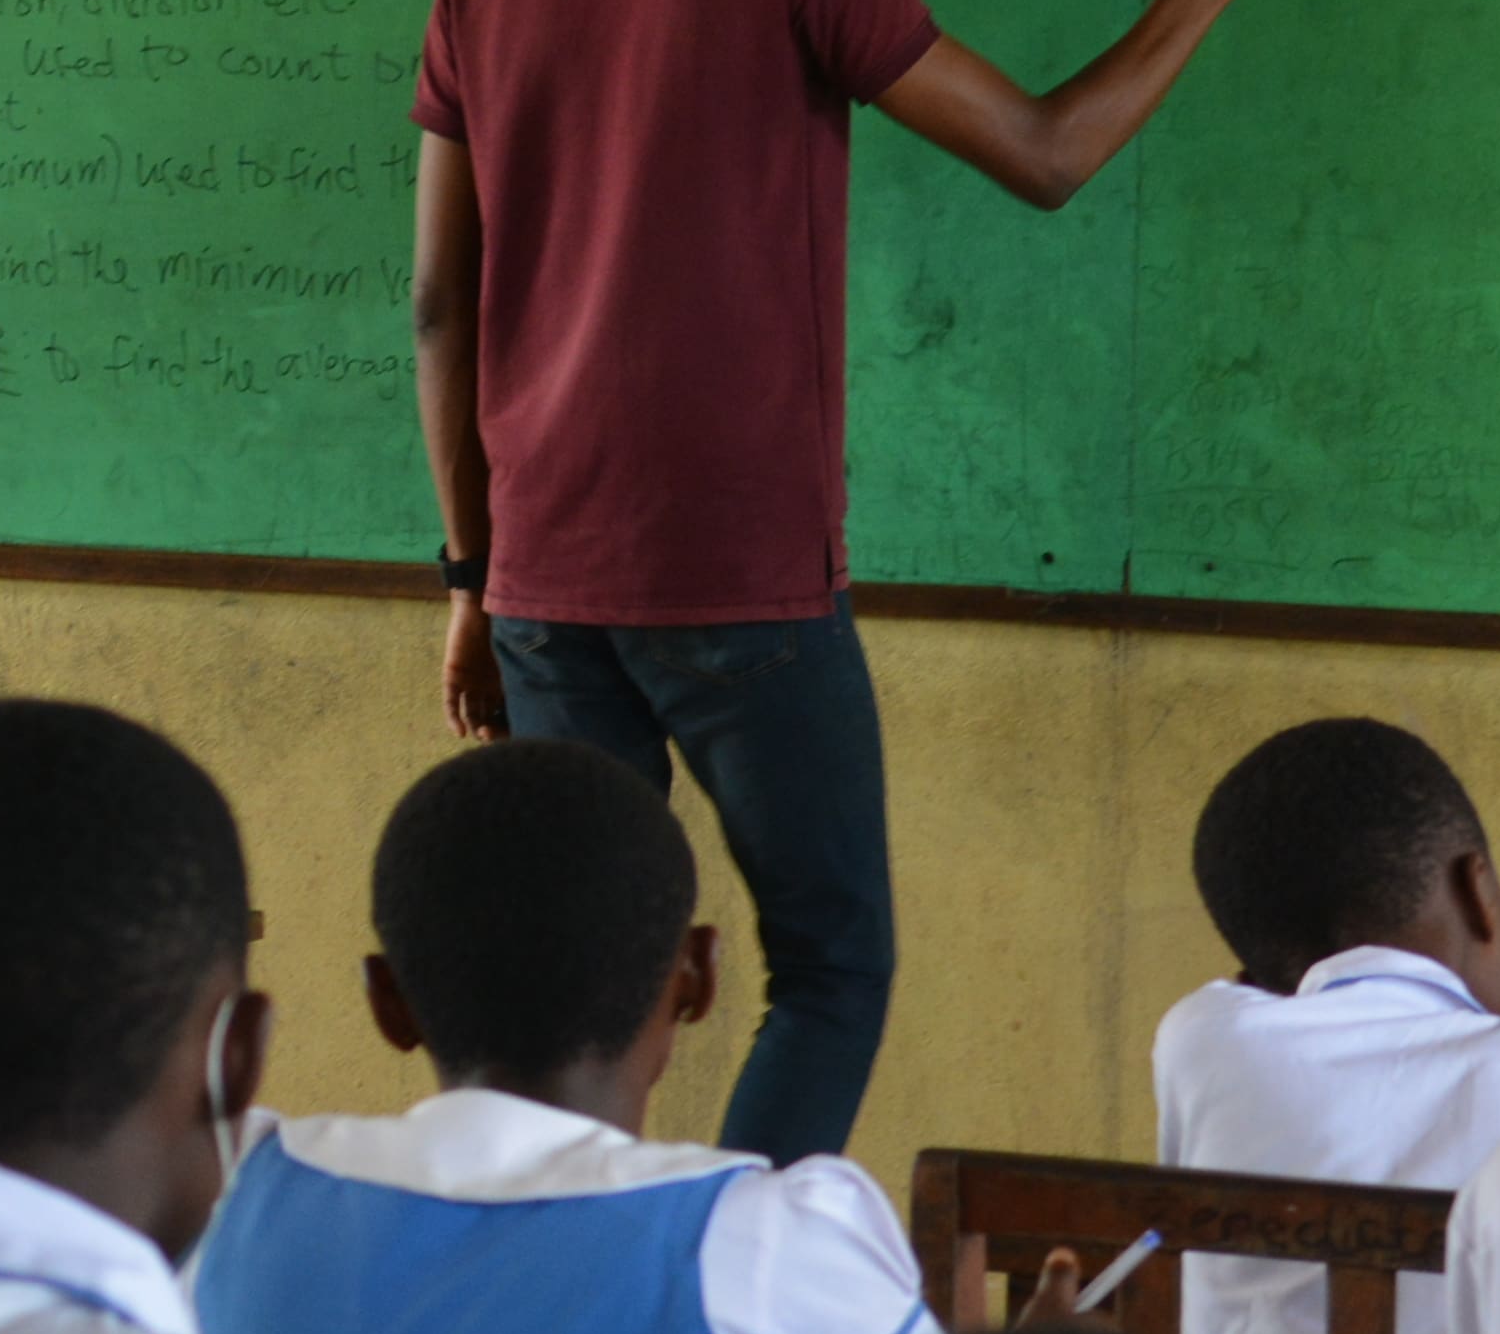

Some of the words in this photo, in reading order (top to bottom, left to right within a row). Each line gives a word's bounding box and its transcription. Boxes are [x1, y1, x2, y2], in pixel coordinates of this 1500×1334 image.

[143, 40, 190, 77] to
[216, 40, 352, 80] count
[137, 149, 220, 197] used
[238, 145, 276, 191] to
[282, 147, 360, 197] find
[71, 239, 140, 293] the
[159, 246, 362, 296] minimum
[43, 332, 80, 383] to
[105, 331, 186, 389] find
[202, 337, 267, 395] the
